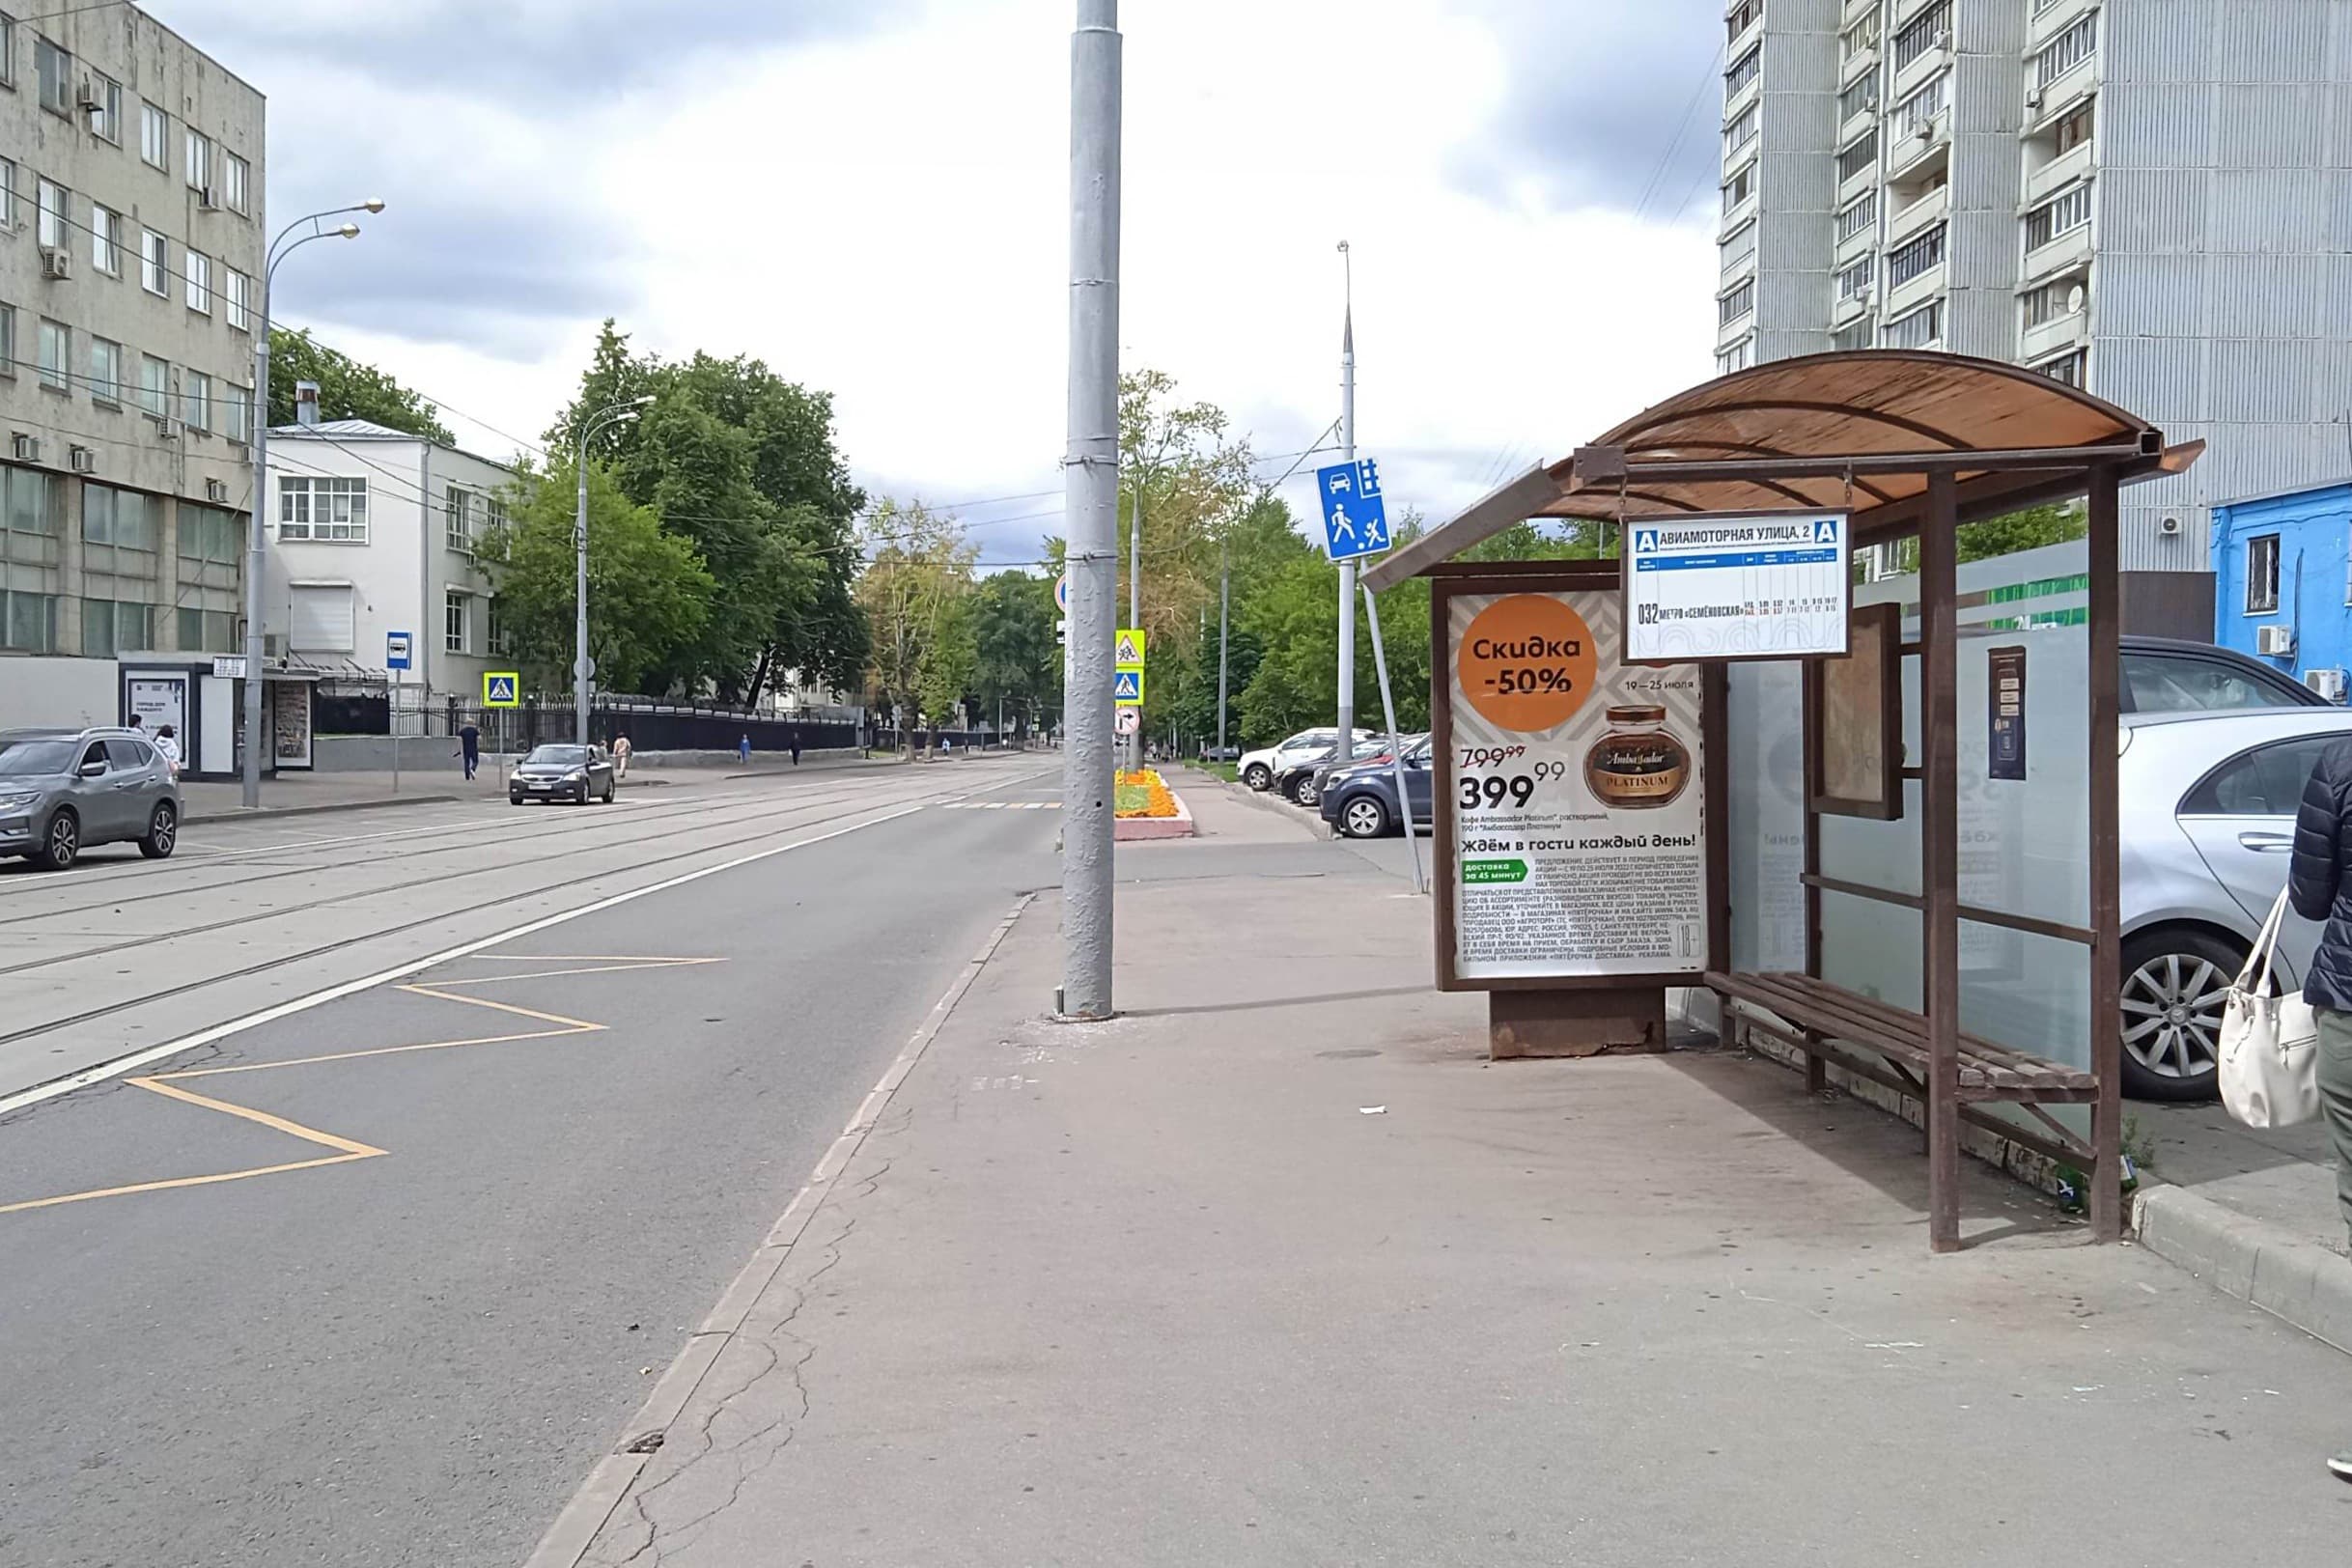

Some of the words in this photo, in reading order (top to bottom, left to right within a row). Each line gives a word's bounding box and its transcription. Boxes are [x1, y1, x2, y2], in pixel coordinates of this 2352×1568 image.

[1660, 528, 1753, 546] АВИАМОТОРНАЯ
[1758, 526, 1800, 541] УЛИЦА,
[1803, 526, 1810, 538] 2
[1638, 603, 1659, 625] 032
[1659, 608, 1683, 620] МЕТРО
[1684, 604, 1744, 619] «СЕМЁНОВСКАЯ»
[1473, 636, 1581, 659] Скидка
[1484, 667, 1572, 695] -50%
[1665, 680, 1694, 690] июля
[1460, 775, 1534, 810] 399
[1534, 761, 1565, 782] 99
[1607, 776, 1668, 788] PLATINUM
[1461, 838, 1510, 852] Ждём
[1516, 841, 1524, 851] в
[1529, 839, 1574, 851] гости
[1579, 835, 1647, 849] каждый
[1652, 834, 1695, 847] день!
